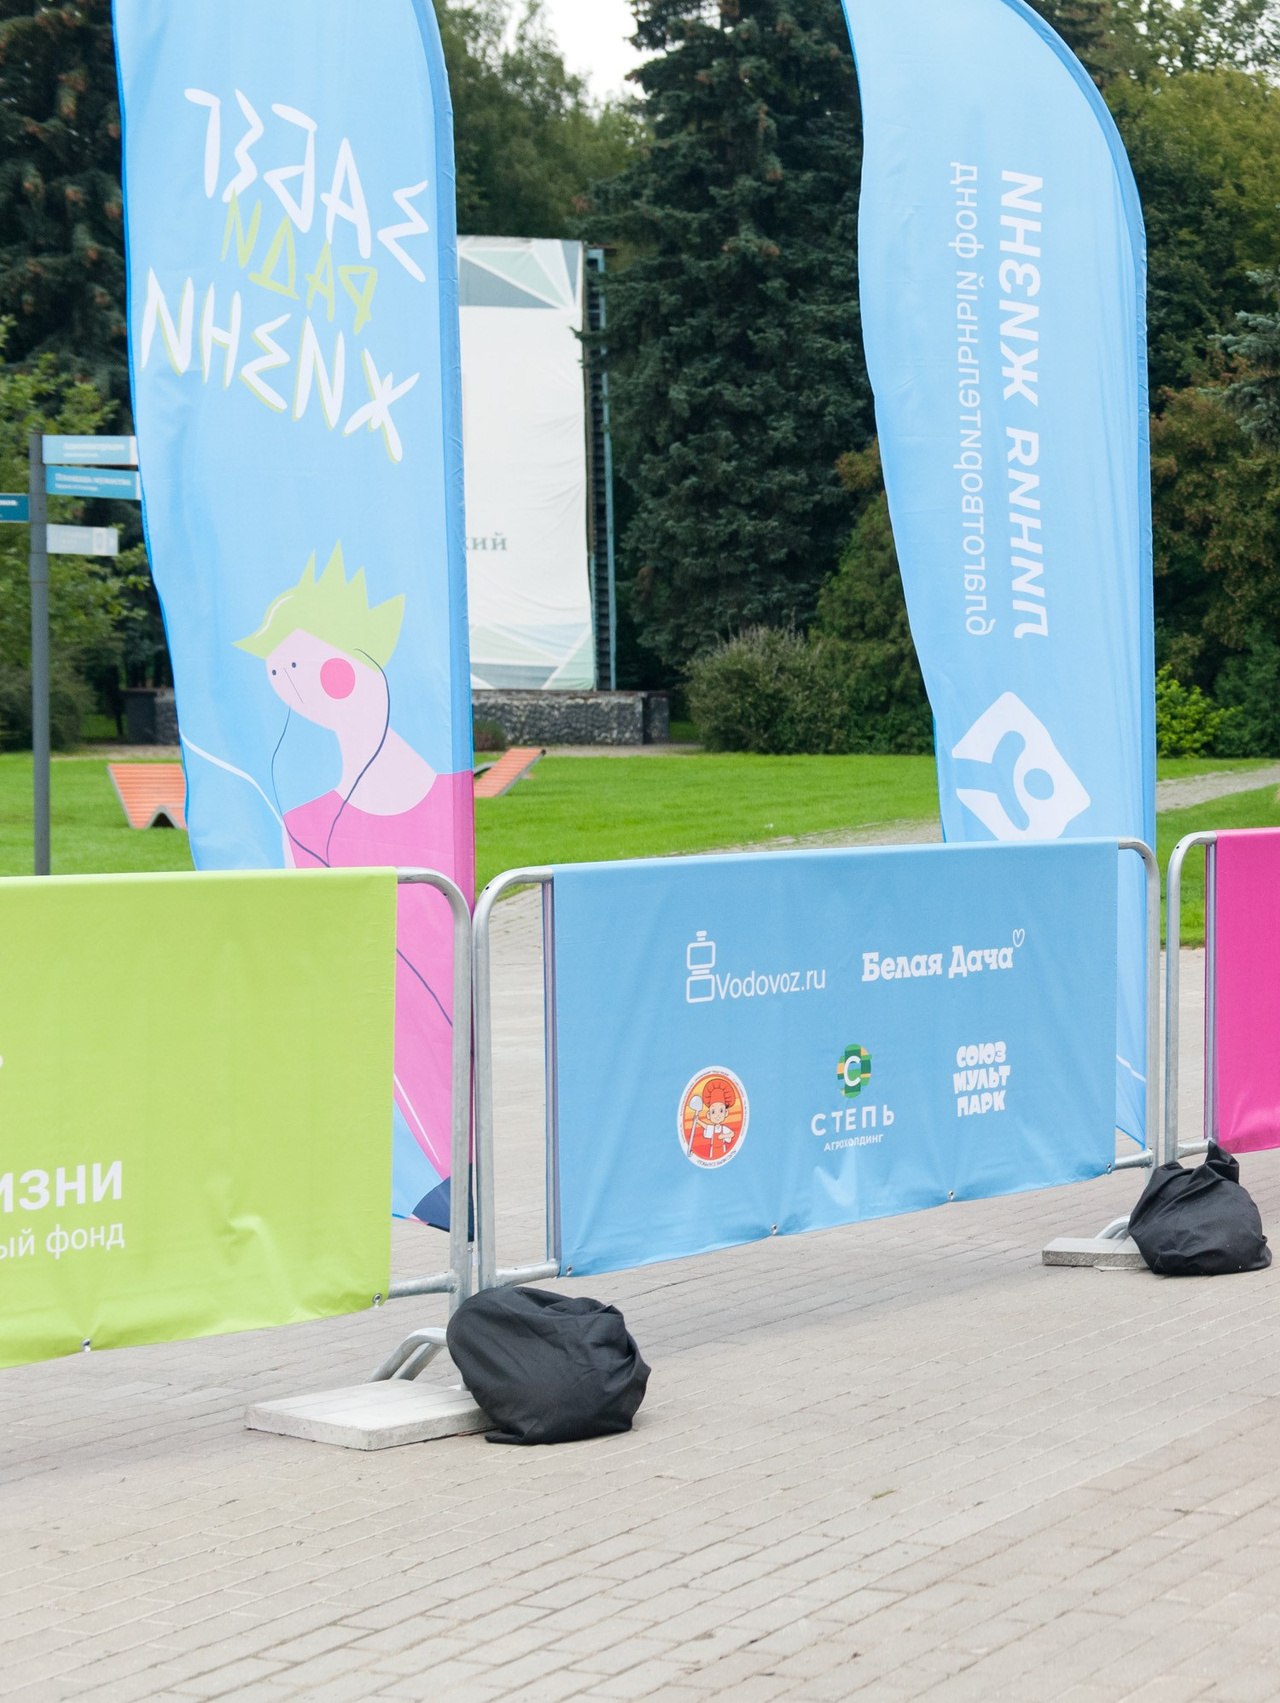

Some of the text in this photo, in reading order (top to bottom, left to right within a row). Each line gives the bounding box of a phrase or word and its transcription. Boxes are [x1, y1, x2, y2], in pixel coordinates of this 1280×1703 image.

[466, 530, 507, 551] ий
[861, 944, 1014, 982] Белая Дача
[716, 967, 826, 1000] Vodovoz.ru
[956, 1040, 1007, 1067] СОЮЗ
[953, 1065, 1011, 1094] МУЛЬТ
[957, 1090, 1006, 1118] ПАРК
[811, 1104, 895, 1137] СТЕПЬ
[823, 1133, 884, 1152] АГРОХОЛДИНГ
[46, 1223, 125, 1260] фонд
